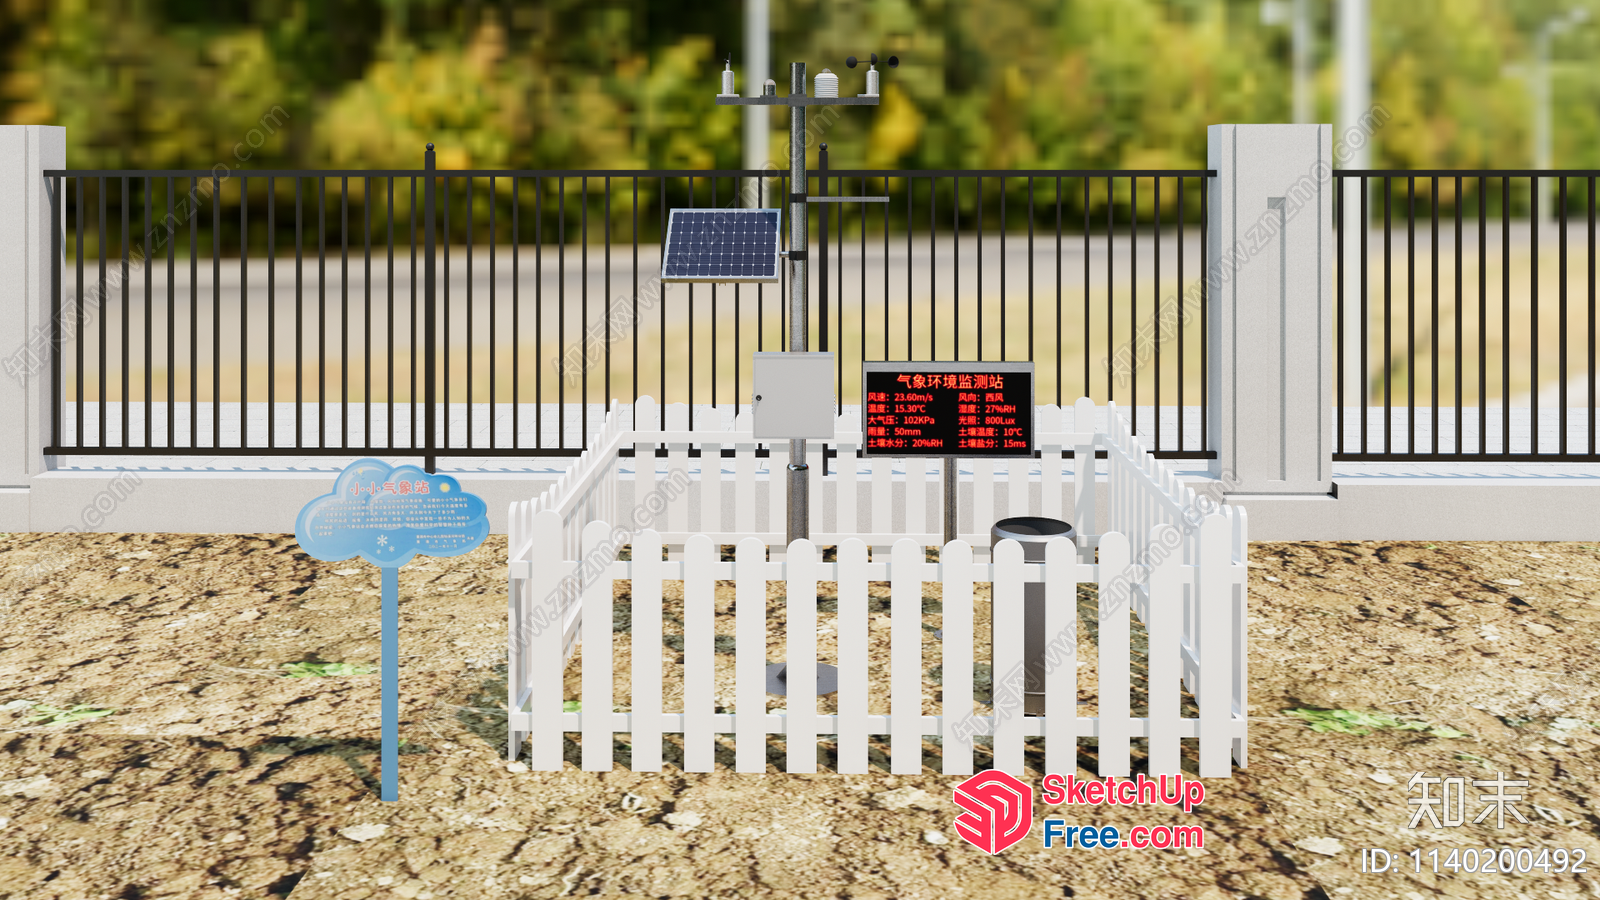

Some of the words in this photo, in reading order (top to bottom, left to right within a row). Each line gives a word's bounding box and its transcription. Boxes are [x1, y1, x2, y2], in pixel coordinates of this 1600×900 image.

[897, 374, 1004, 389] 气象环境监测站
[349, 480, 430, 497] 小小气象站
